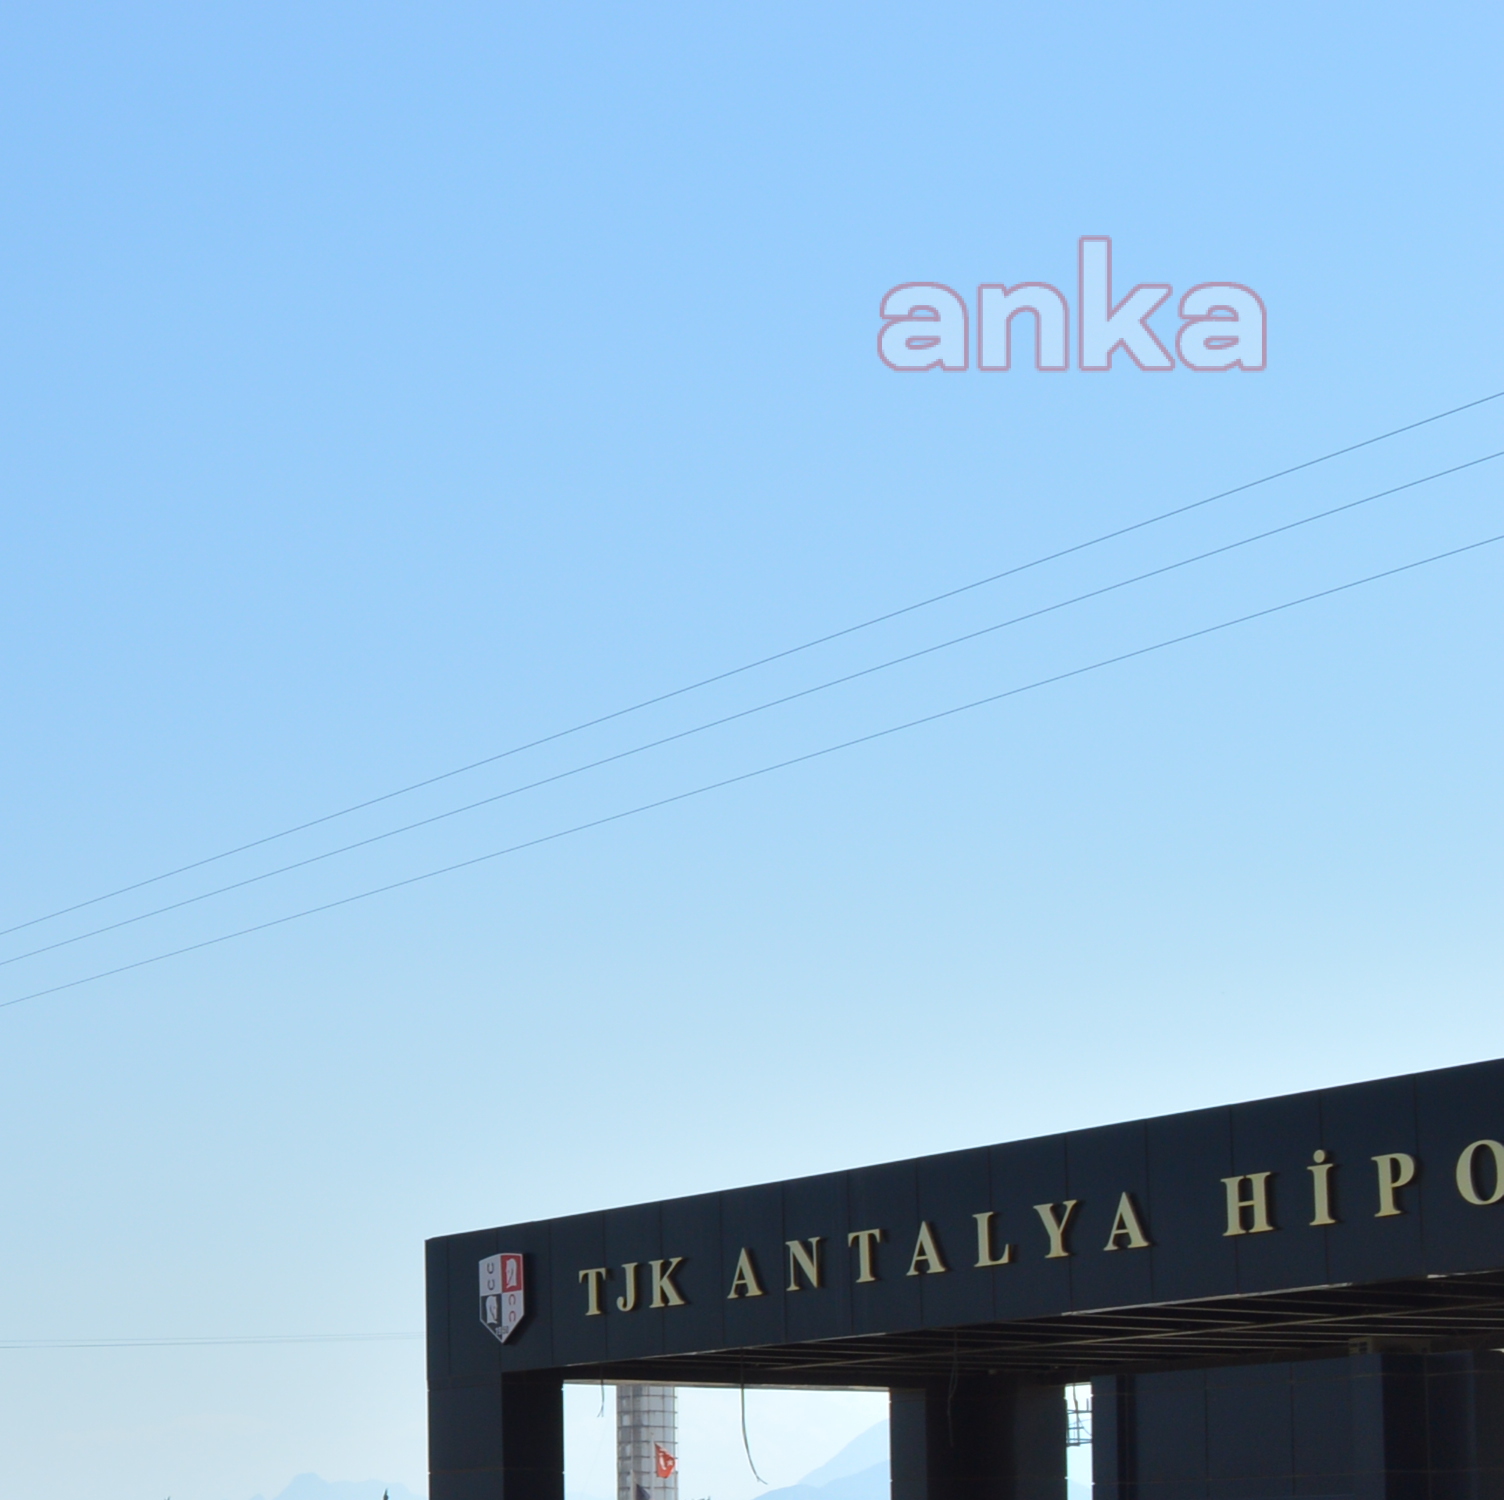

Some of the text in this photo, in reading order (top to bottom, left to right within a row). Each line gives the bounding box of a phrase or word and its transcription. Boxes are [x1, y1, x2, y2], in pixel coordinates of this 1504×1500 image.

[579, 1139, 1504, 1316] TJK ANTALYA HİPO
